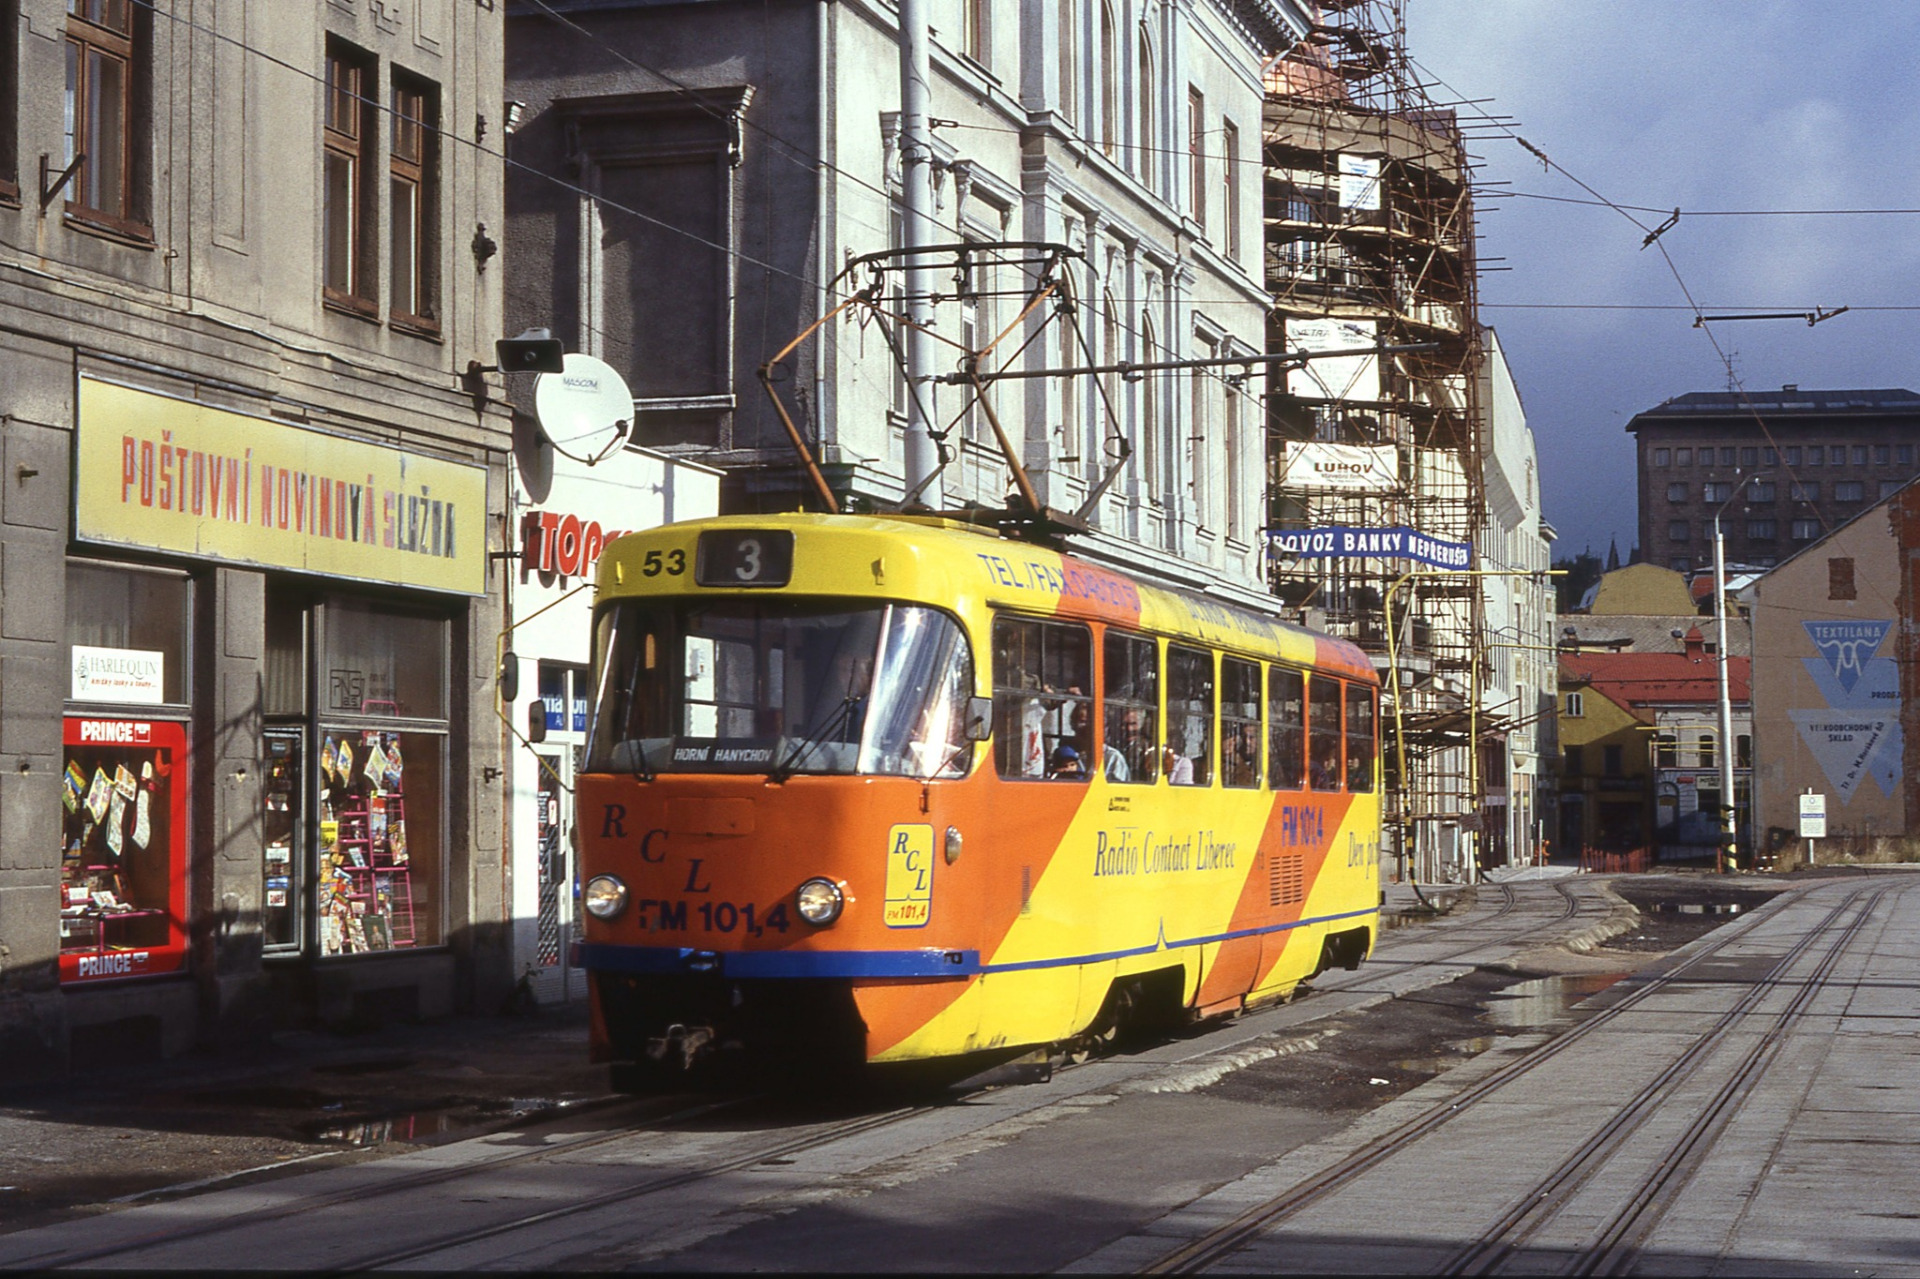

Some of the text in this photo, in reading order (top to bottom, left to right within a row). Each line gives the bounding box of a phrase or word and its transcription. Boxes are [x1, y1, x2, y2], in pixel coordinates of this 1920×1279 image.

[1314, 462, 1373, 474] LUHOV
[122, 429, 252, 526] POŠTOVNÍ
[261, 465, 376, 546] NOVINOVÁ
[538, 511, 633, 577] TOP
[1344, 533, 1401, 552] BANKY
[643, 549, 686, 577] 53
[736, 540, 761, 580] 3
[1815, 627, 1880, 638] TEXTILANA
[90, 657, 157, 680] HARLEQUIN
[81, 721, 133, 742] PRINCE
[1810, 722, 1873, 732] VELKOOBCHODNÍ
[1828, 734, 1853, 742] SKLAD
[674, 746, 772, 761] HORNÍ HANYCHOV
[1282, 806, 1298, 847] FM
[1094, 831, 1139, 876] Radio
[1143, 831, 1191, 874] Contact
[1196, 830, 1236, 870] Liberec
[638, 899, 790, 938] FM 101,4
[887, 904, 926, 920] FM 101,4
[79, 954, 131, 977] PRINCE
